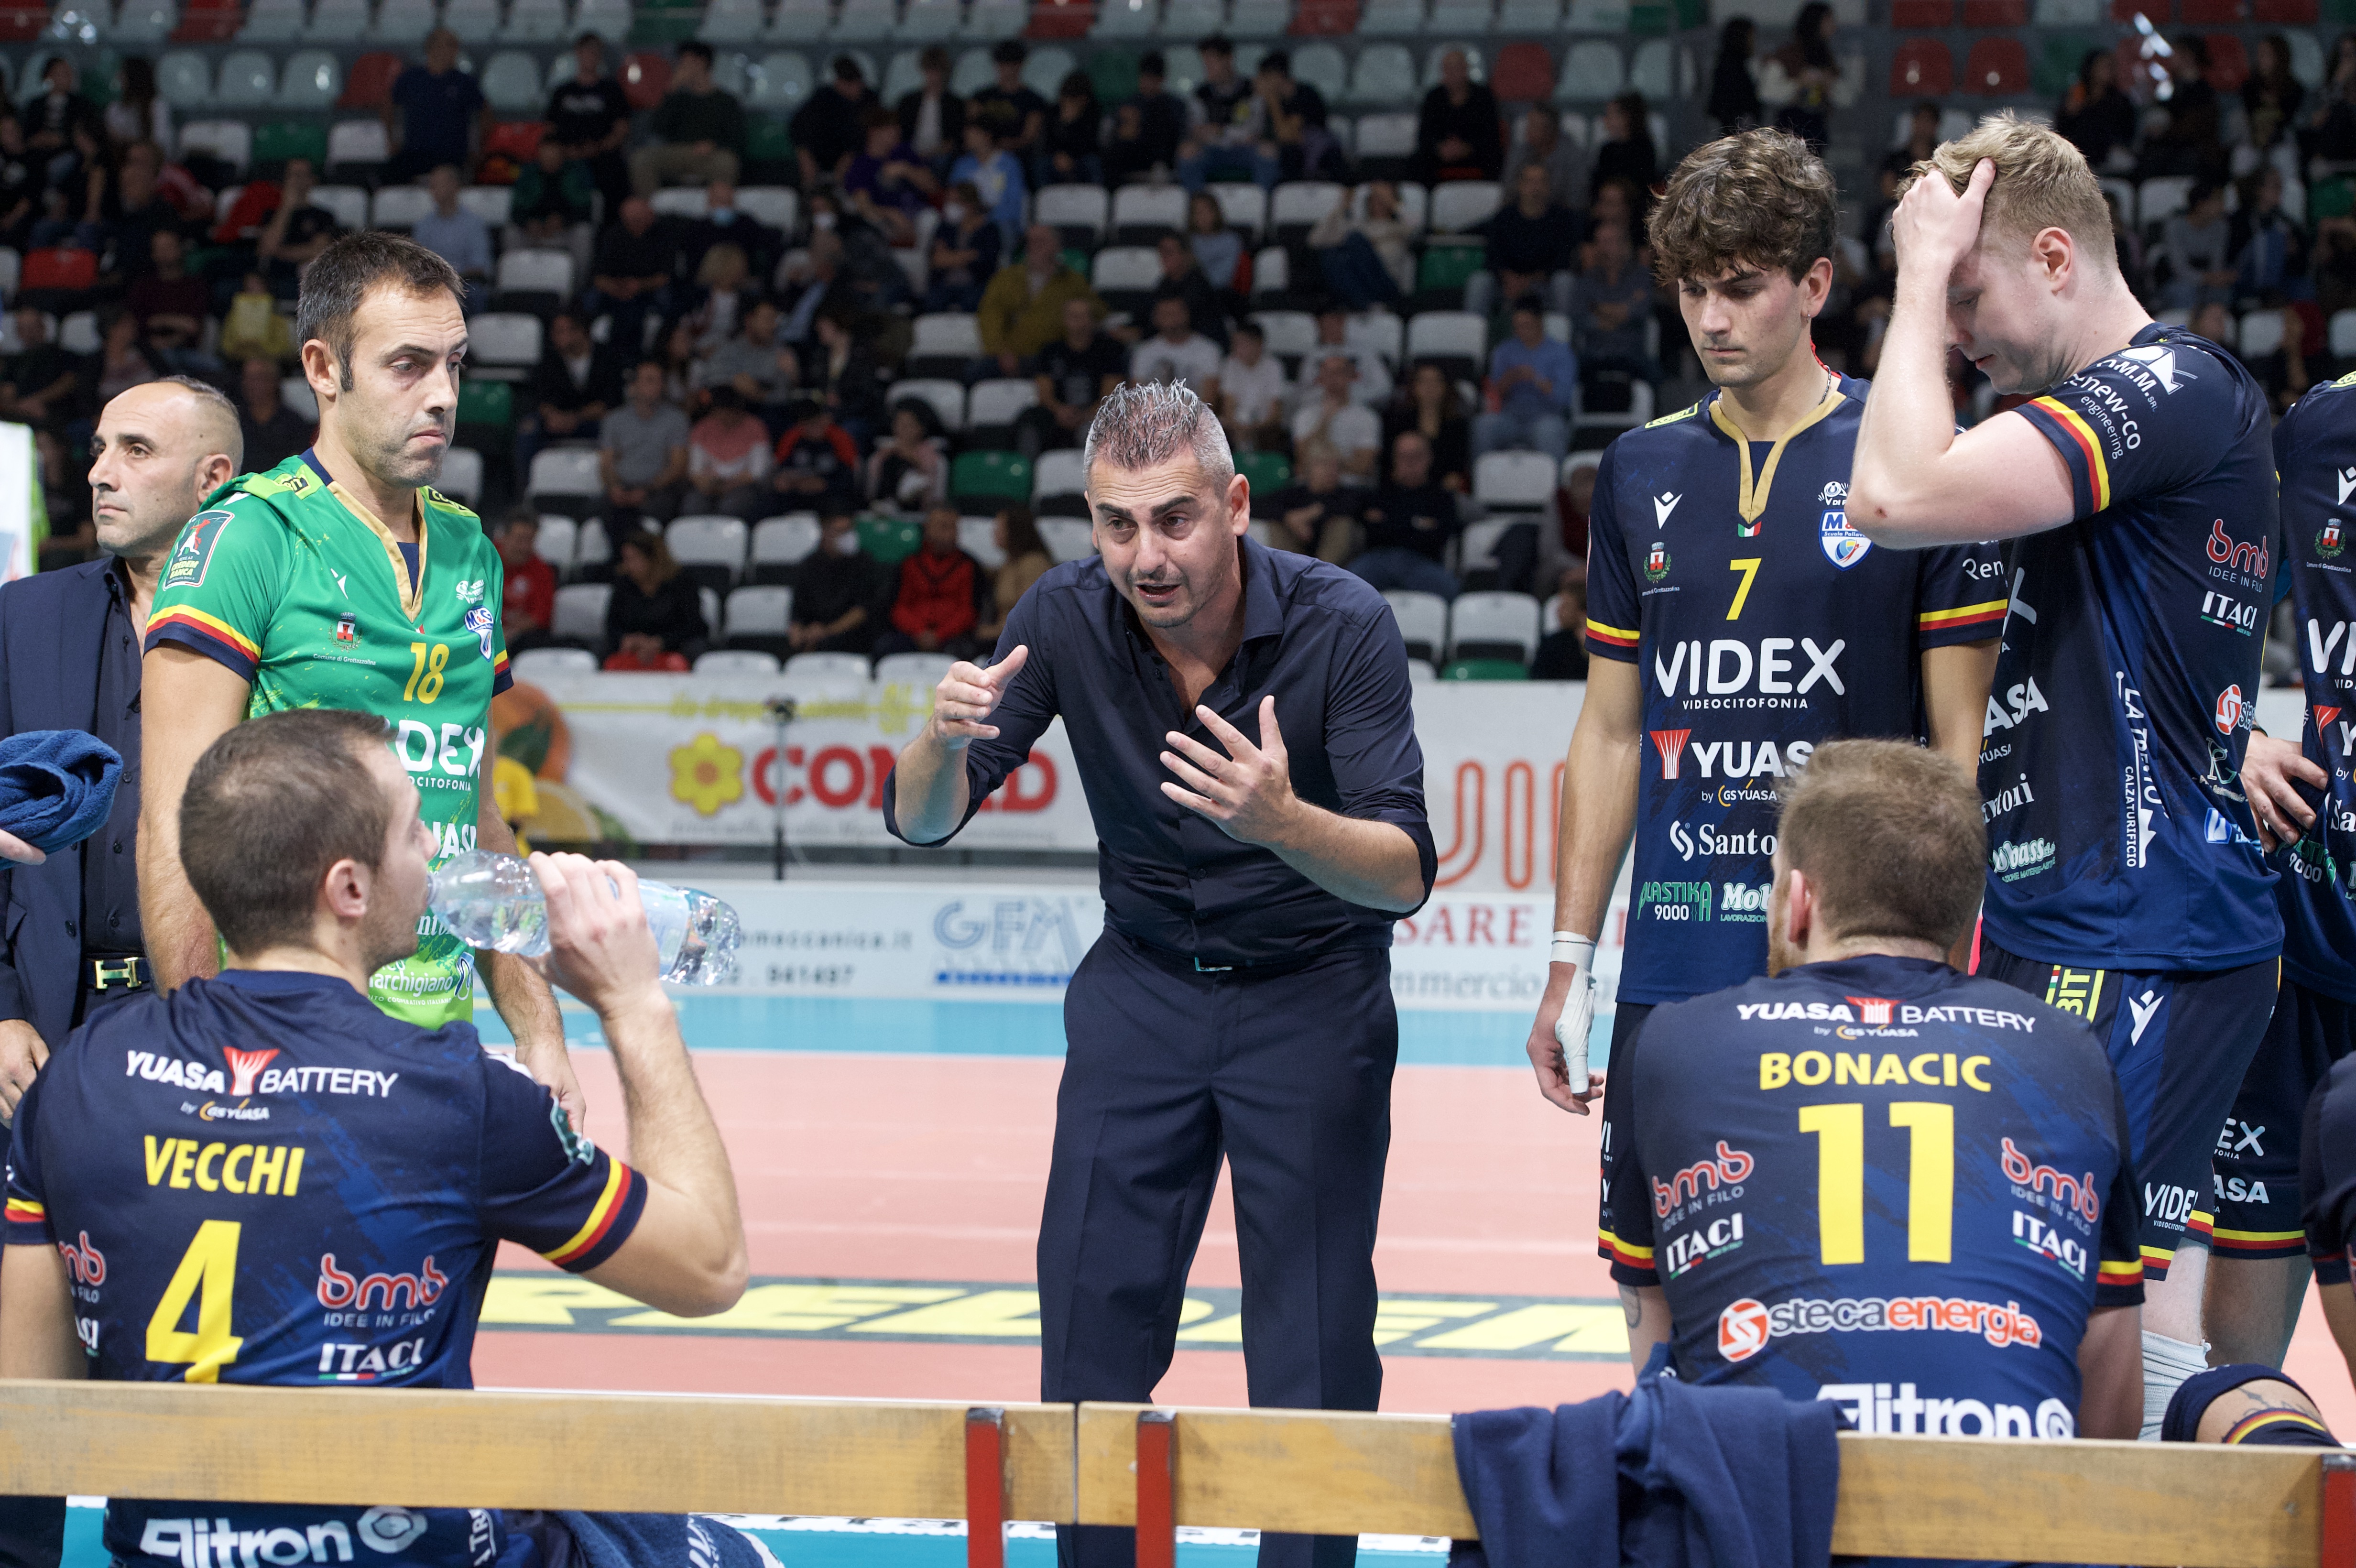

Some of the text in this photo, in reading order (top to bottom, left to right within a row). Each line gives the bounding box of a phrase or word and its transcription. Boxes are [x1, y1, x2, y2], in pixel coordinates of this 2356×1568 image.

[2081, 396, 2124, 459] engineering
[2206, 519, 2269, 579] bmb
[1726, 558, 1762, 621] 7
[2209, 566, 2262, 593] IDEE IN FILO
[2202, 590, 2258, 630] ITACI
[343, 656, 376, 665] Grottazzolina
[404, 642, 449, 704] 18
[1655, 638, 1846, 697] VIDEX
[1682, 698, 1809, 710] VIDEOCITOFONIA
[1983, 675, 2049, 737] ASA
[395, 719, 484, 780] DEX
[1691, 740, 1814, 778] YUAS
[408, 775, 471, 792] OCITOFONIA
[752, 744, 1059, 814] COD
[1702, 791, 1714, 804] by
[2335, 767, 2349, 781] by
[1699, 823, 1778, 855] Santo
[2125, 766, 2137, 867] CALZATURIFICIO
[2289, 852, 2323, 883] 9000
[1654, 904, 1689, 921] 9000
[1720, 914, 1768, 922] LAVORAZION
[387, 996, 426, 1005] COOPERATIVO
[1736, 1002, 2037, 1034] YUASA BATTERY
[126, 1050, 398, 1098] YUASA BATTERY
[1759, 1050, 1992, 1093] BONACIC
[144, 1134, 305, 1197] VECCHI
[1652, 1140, 1755, 1219] bmb
[1799, 1101, 1954, 1266] 11
[2001, 1136, 2100, 1223] bmb
[2214, 1174, 2270, 1204] ASA
[1707, 1185, 1744, 1207] FILO
[2011, 1184, 2046, 1208] IDEE
[2066, 1210, 2092, 1236] FILO
[2145, 1182, 2199, 1224] VIDE
[59, 1230, 107, 1286] mb
[1666, 1212, 1744, 1273] ITACI
[2012, 1210, 2087, 1275] ITACI
[146, 1220, 244, 1383] 4
[317, 1252, 449, 1311] bmb
[324, 1312, 369, 1328] IDEE
[375, 1314, 395, 1328] IN
[1769, 1296, 2043, 1349] stecaenergia
[318, 1337, 425, 1372] ITACI
